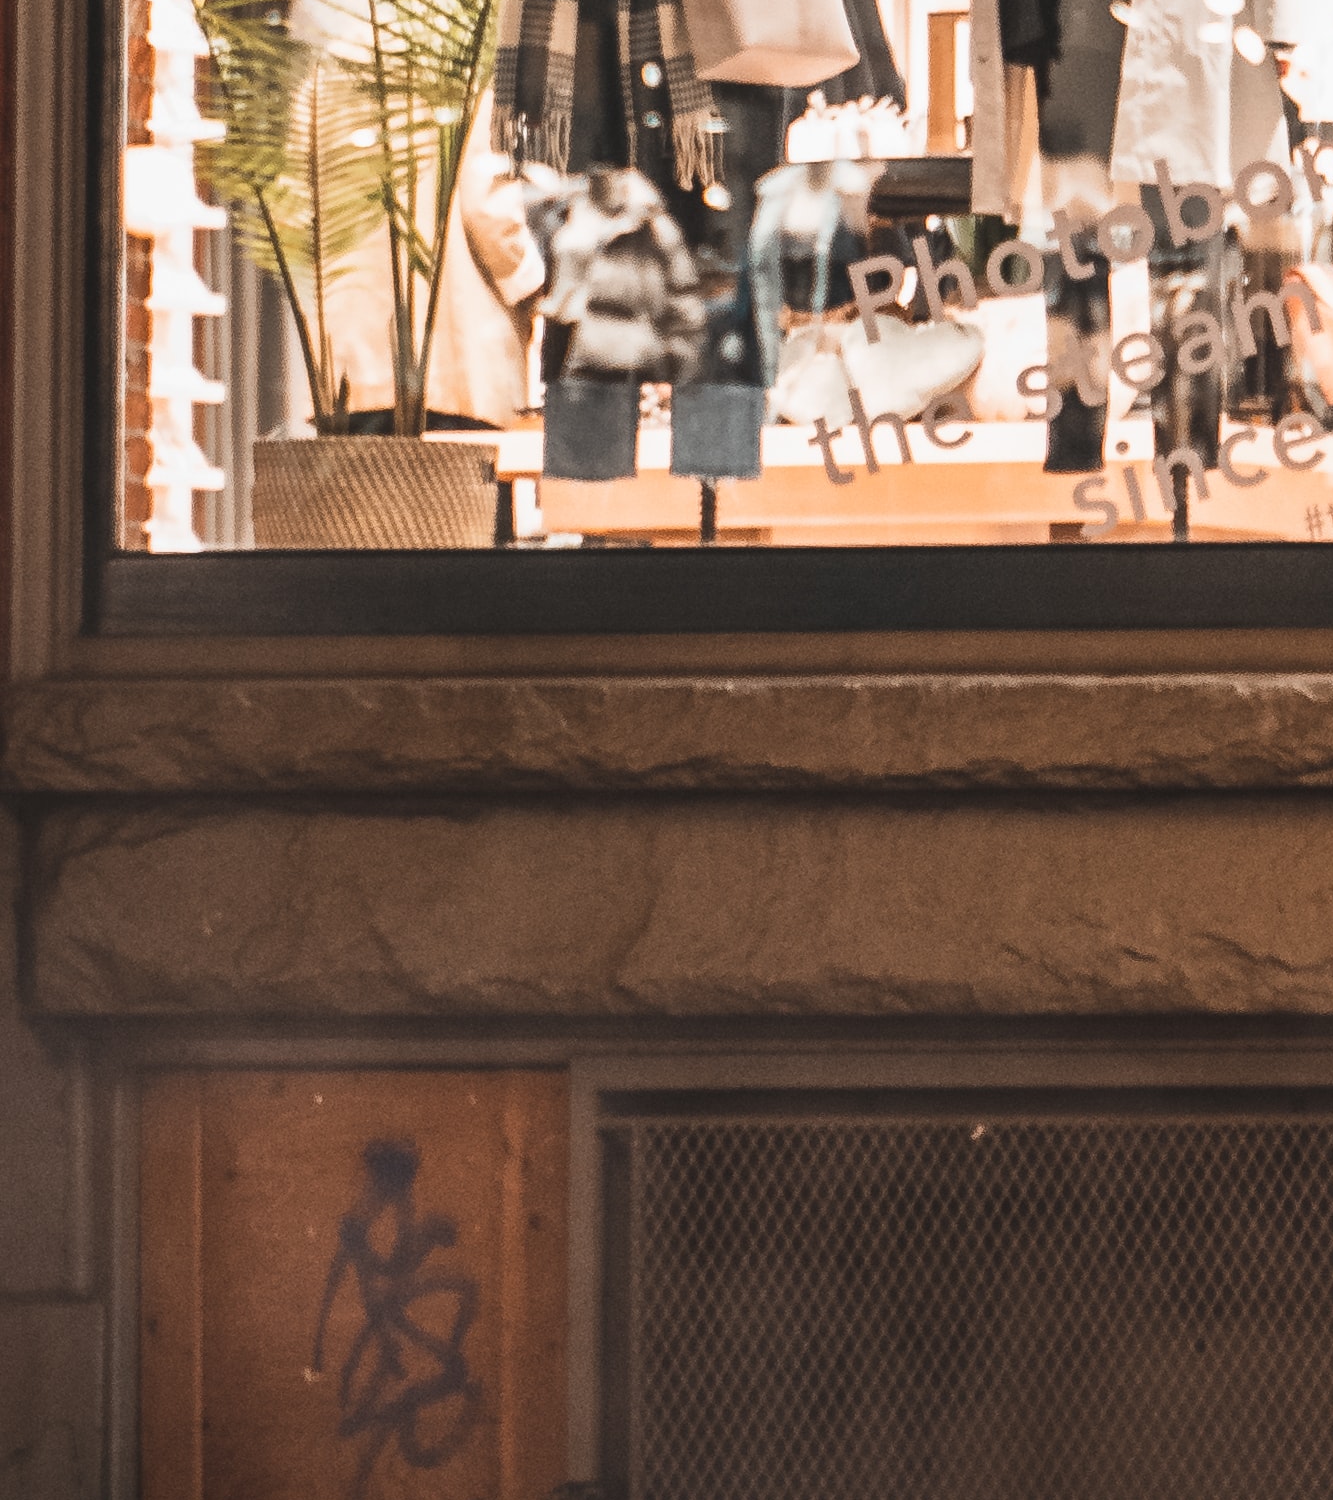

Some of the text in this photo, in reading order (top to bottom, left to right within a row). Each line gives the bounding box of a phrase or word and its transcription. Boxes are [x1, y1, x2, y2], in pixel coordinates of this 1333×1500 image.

[807, 387, 974, 487] the
[1016, 277, 1323, 422] steam
[1072, 410, 1327, 538] since
